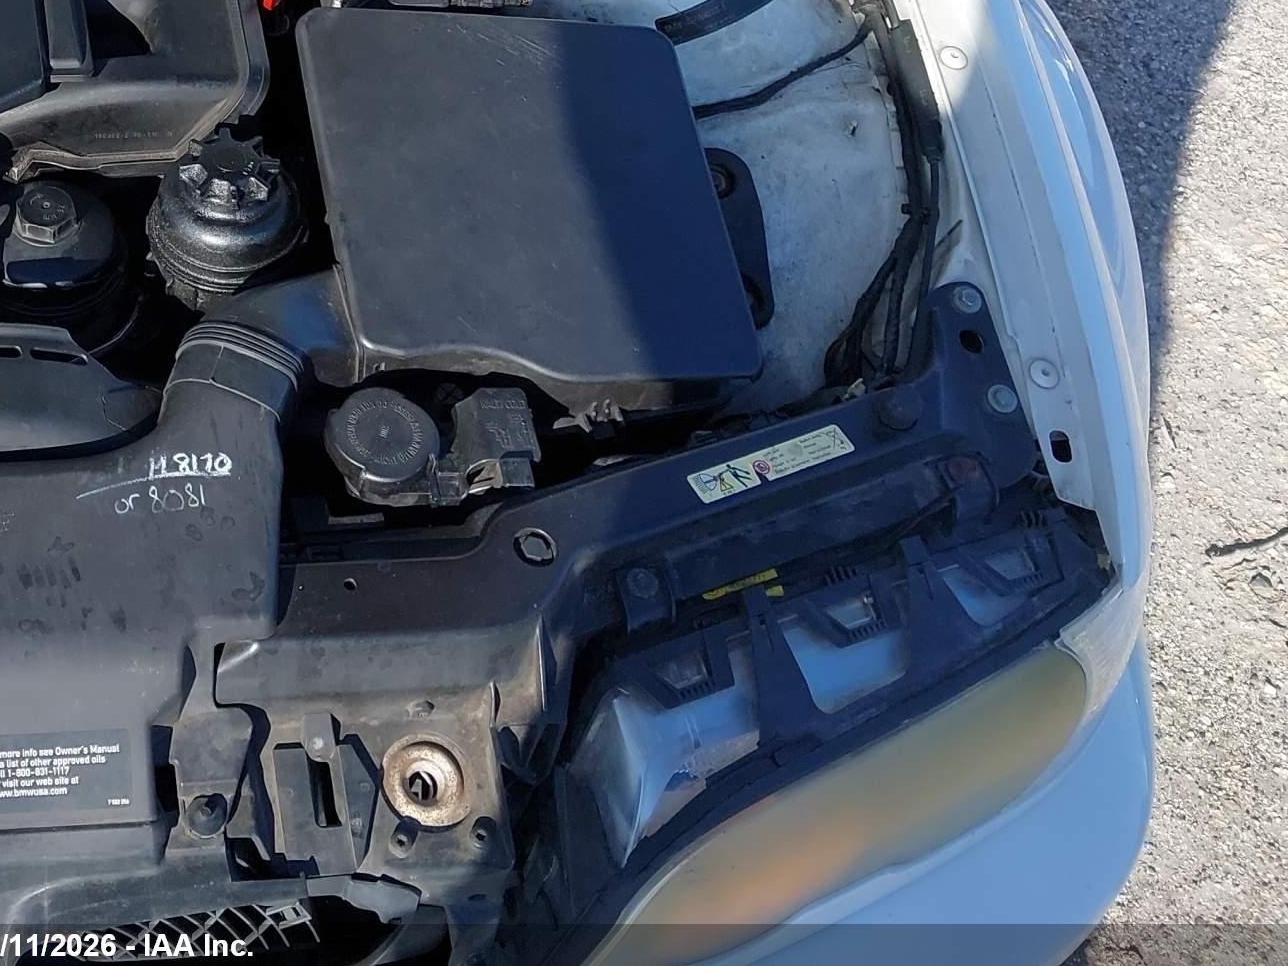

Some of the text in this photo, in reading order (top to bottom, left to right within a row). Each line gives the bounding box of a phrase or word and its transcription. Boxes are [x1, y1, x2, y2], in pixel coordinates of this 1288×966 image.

[114, 482, 206, 514] or 8081
[0, 750, 20, 759] more
[22, 748, 38, 757] info
[39, 749, 54, 757] see
[55, 746, 88, 756] Owner's
[90, 744, 120, 754] Manual
[0, 761, 5, 769] a
[6, 759, 19, 768] list
[20, 758, 29, 767] of
[30, 757, 52, 766] other
[53, 756, 90, 768] approved
[91, 755, 106, 764] oils
[2, 779, 19, 788] visit
[20, 779, 35, 787] our
[36, 777, 53, 786] web
[54, 776, 70, 785] site
[70, 775, 80, 784] at
